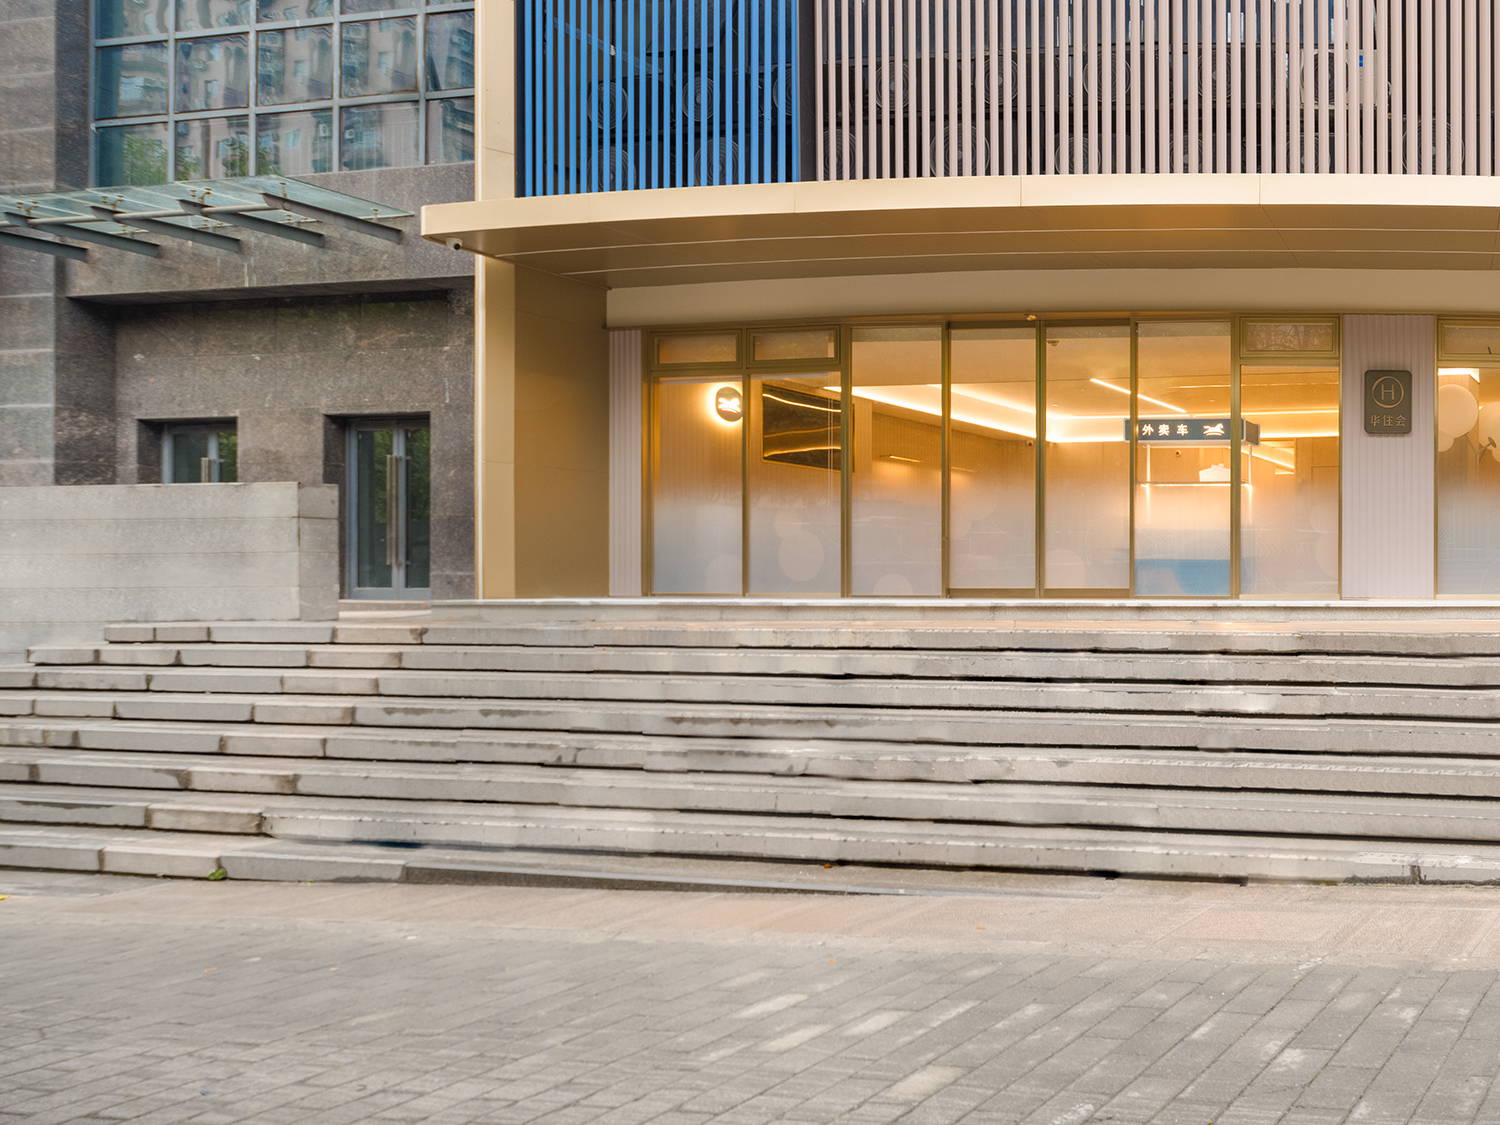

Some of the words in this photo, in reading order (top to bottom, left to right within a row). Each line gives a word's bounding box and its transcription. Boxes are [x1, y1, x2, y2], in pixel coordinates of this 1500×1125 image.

[1370, 414, 1407, 427] 华住会
[1141, 423, 1189, 436] 外卖车
